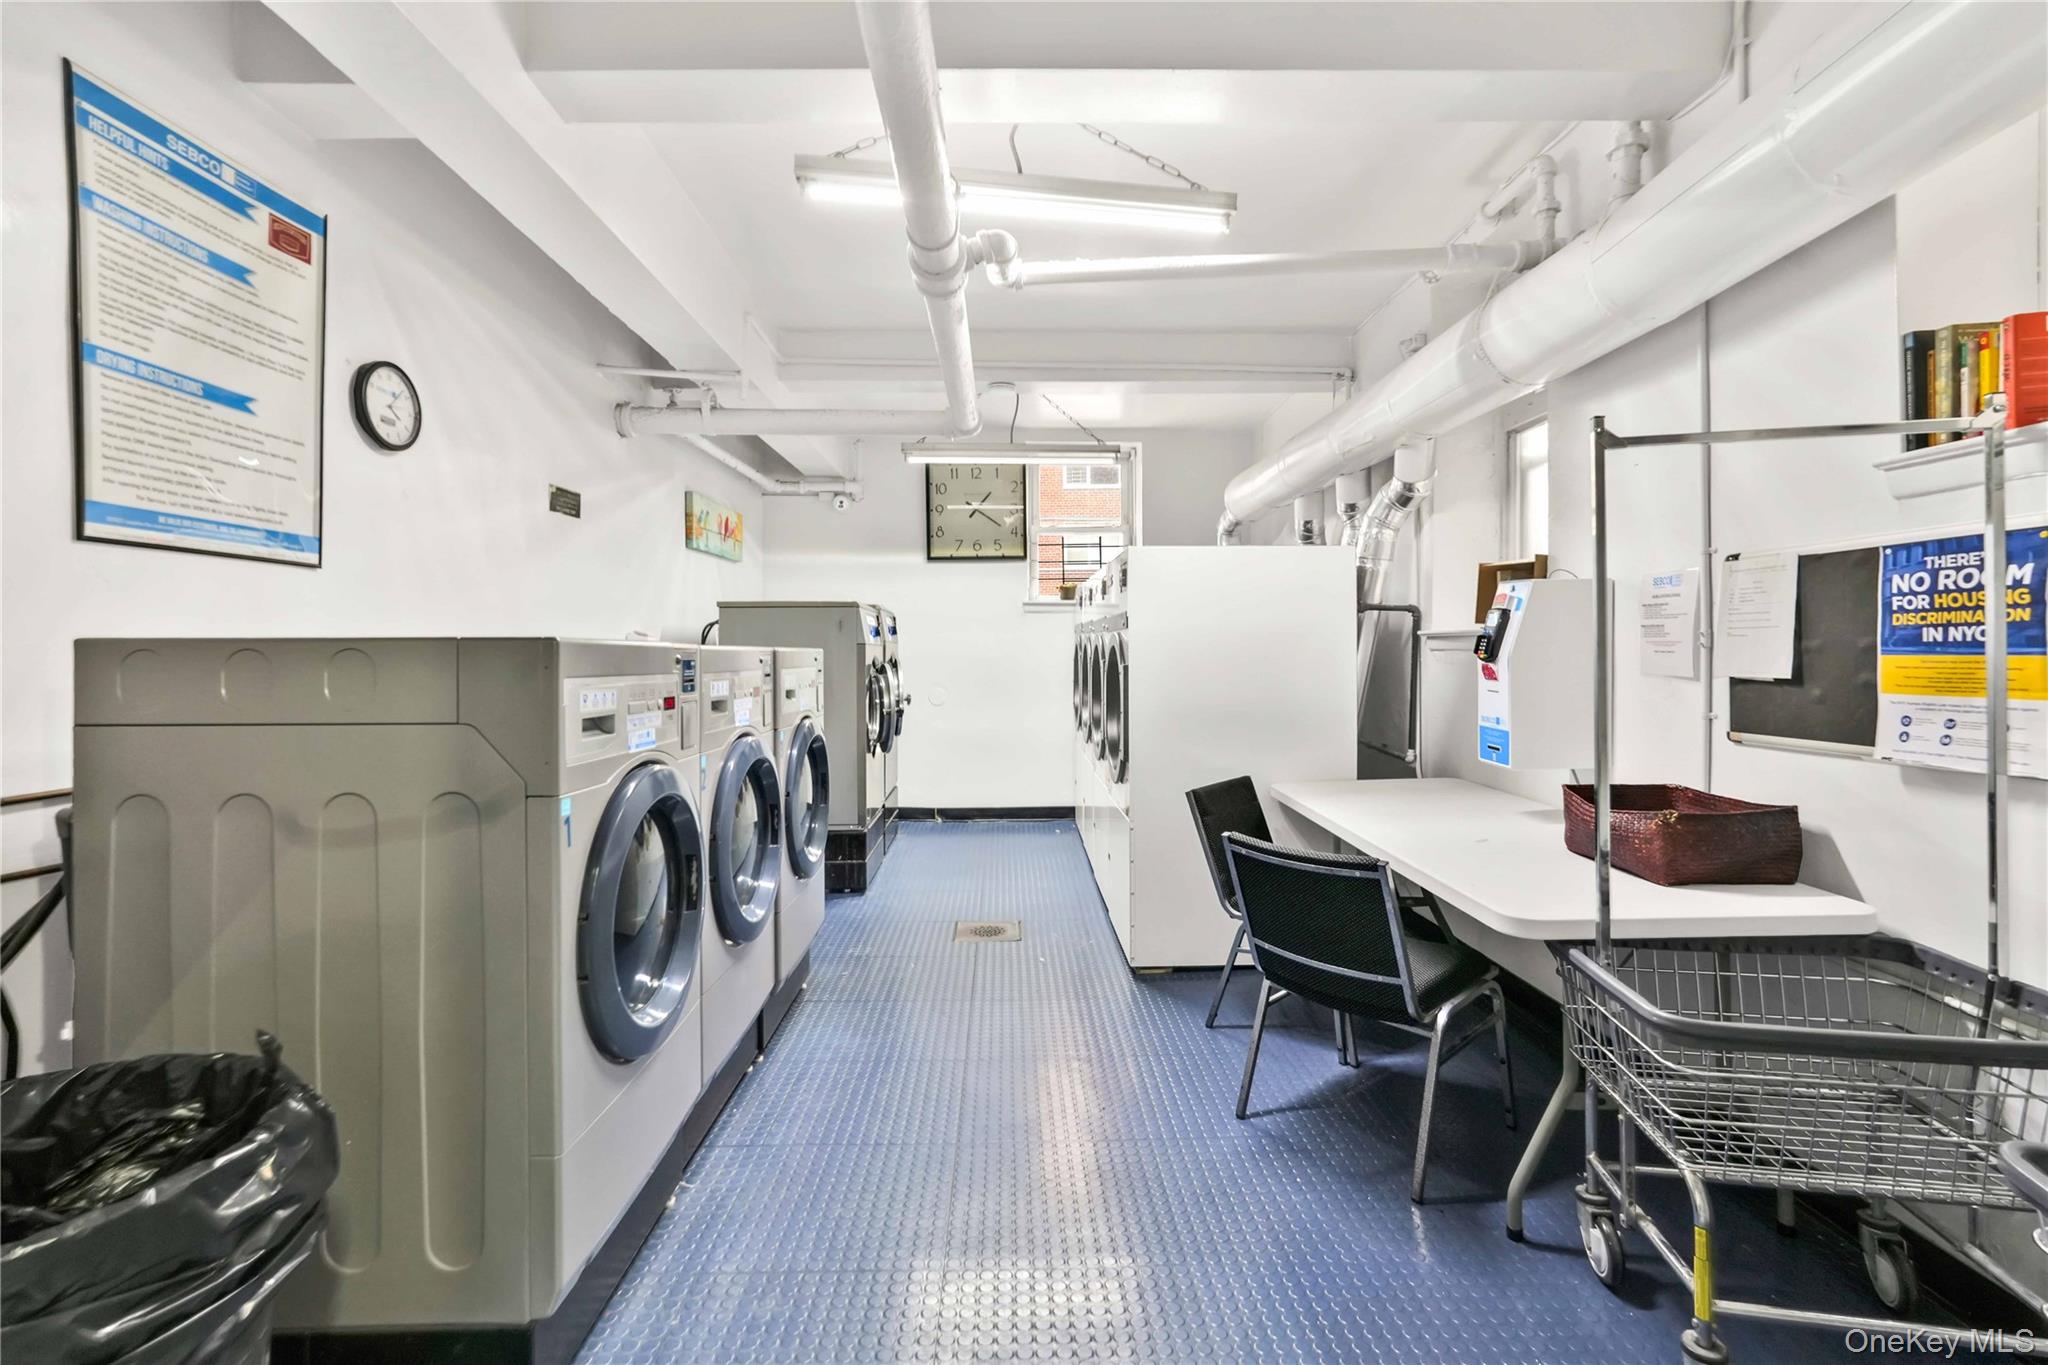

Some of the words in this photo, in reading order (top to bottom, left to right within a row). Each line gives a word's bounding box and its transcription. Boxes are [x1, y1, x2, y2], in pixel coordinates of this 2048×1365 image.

[88, 114, 138, 154] HELPFUL
[138, 142, 169, 171] HINTS
[165, 133, 222, 177] SEBCO
[95, 349, 136, 374] DRYING
[136, 361, 204, 396] INSTRUCTIONS
[949, 467, 959, 480] 11
[970, 466, 982, 480] 12
[935, 482, 947, 495] 10
[1010, 480, 1019, 493] 2
[935, 504, 944, 516] 9
[935, 525, 945, 538] 8
[1010, 526, 1018, 538] 4
[954, 539, 964, 552] 7
[972, 539, 982, 552] 6
[993, 538, 1002, 552] 5
[1924, 551, 1985, 569] THERE'
[1891, 571, 1931, 594] NO
[1937, 562, 2035, 591] ROM
[1891, 594, 1930, 611] FOR
[1933, 587, 2032, 609] HOUSNG
[1891, 607, 2032, 626] DISCRIMINAON
[1921, 626, 1944, 643] IN
[1947, 625, 1987, 643] NYC
